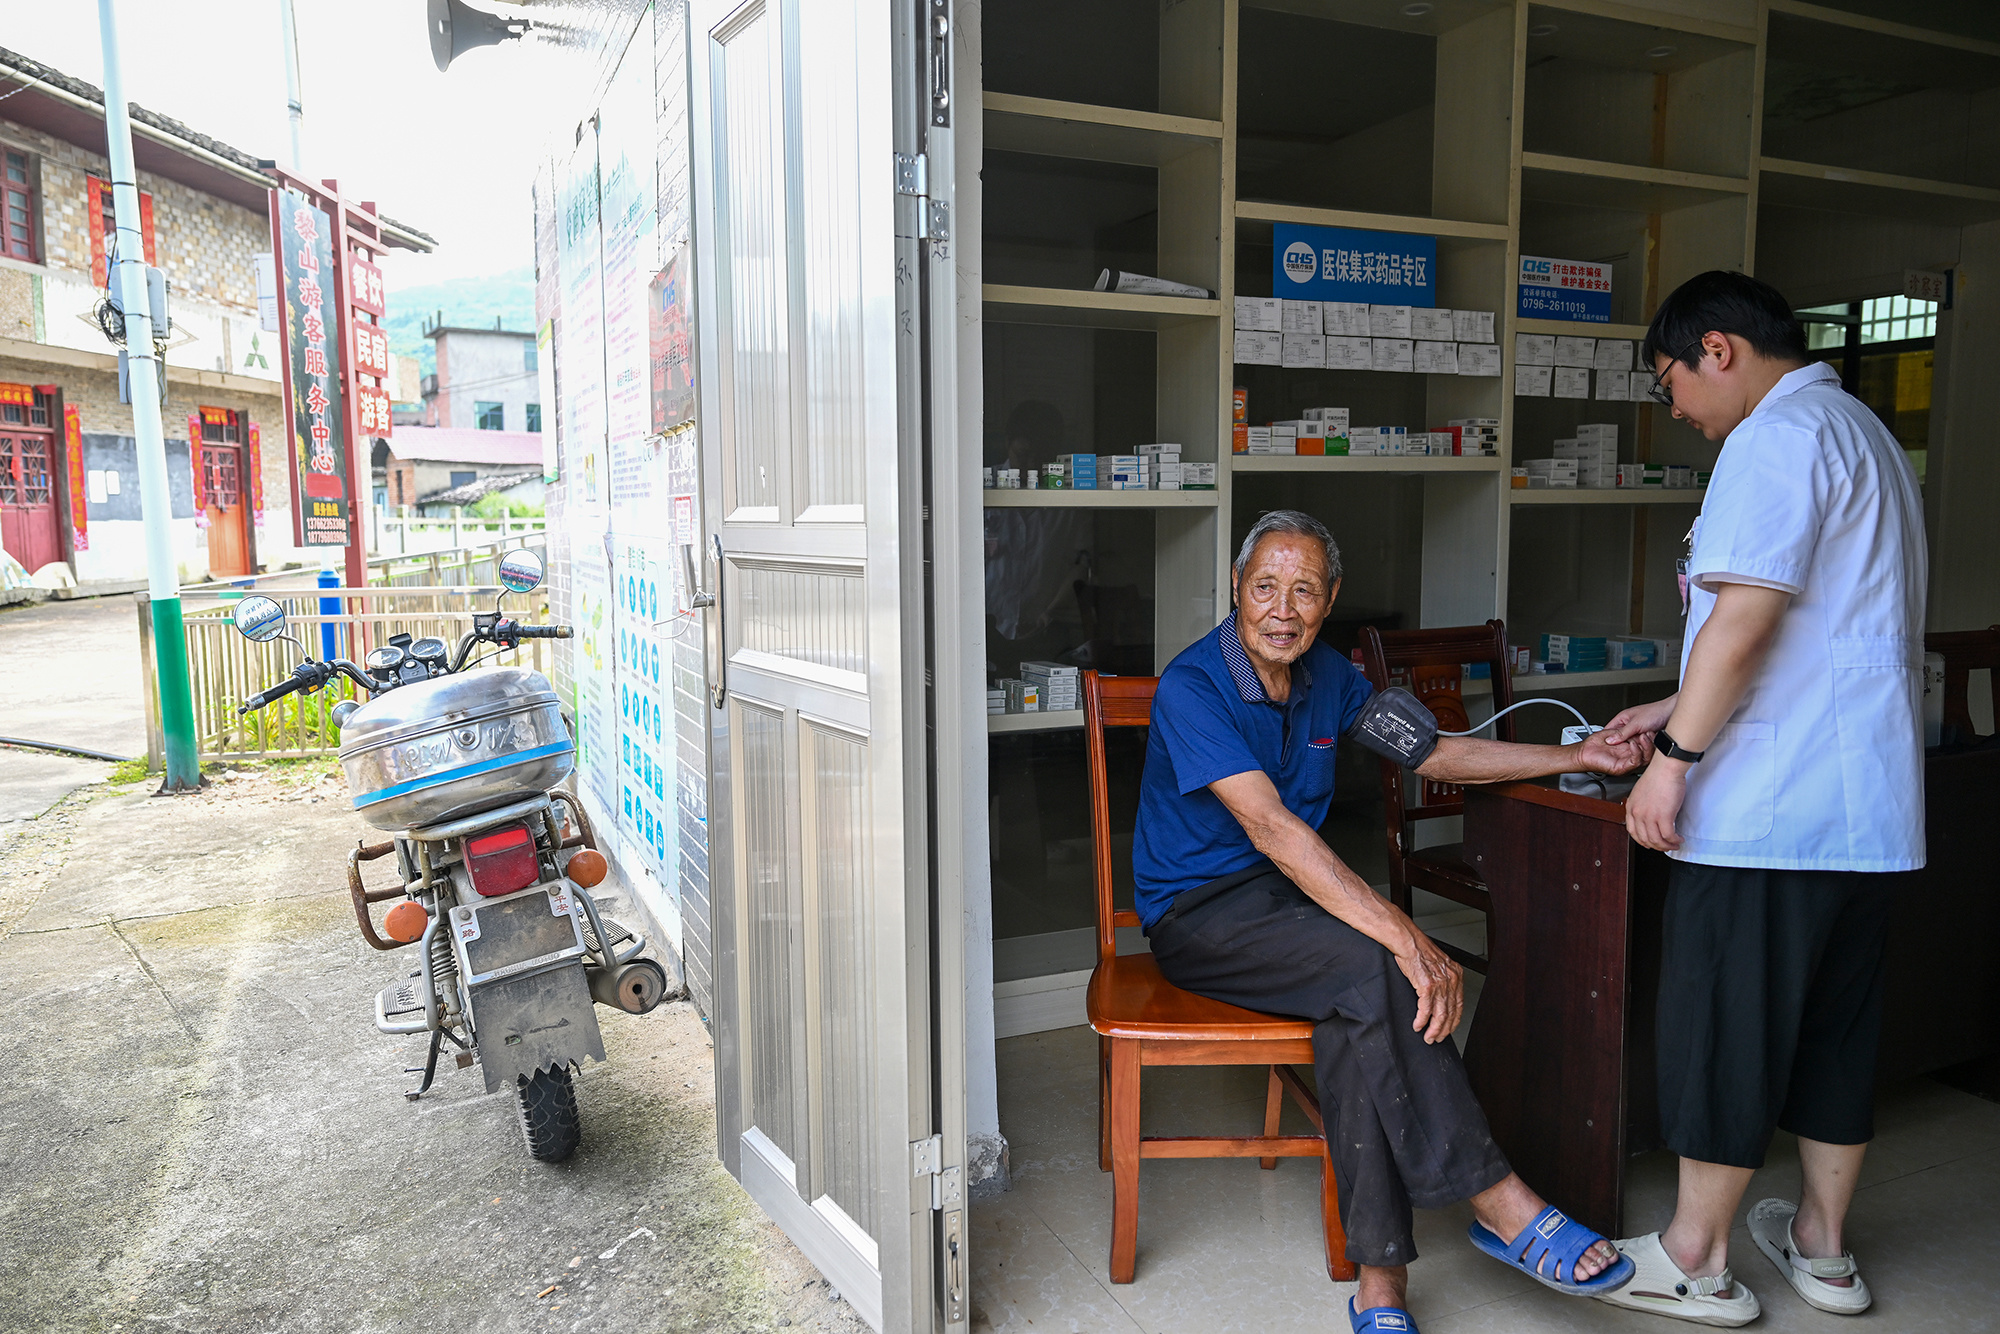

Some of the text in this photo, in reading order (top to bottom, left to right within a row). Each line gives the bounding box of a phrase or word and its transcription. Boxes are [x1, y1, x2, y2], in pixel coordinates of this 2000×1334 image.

[1322, 248, 1427, 287] 医保集采药品专区
[1522, 259, 1551, 274] CHS
[1552, 263, 1602, 278] 打击欺诈骗保
[352, 261, 384, 308] 餐饮
[1521, 273, 1551, 282] 中国医疗保障
[1560, 276, 1610, 291] 维护基金安全
[1909, 273, 1943, 298] 诊察室
[1522, 297, 1586, 313] 0796-2611019
[355, 327, 387, 372] 民宿
[360, 391, 390, 432] 游客
[554, 895, 569, 913] 平安
[460, 921, 476, 938] 一路
